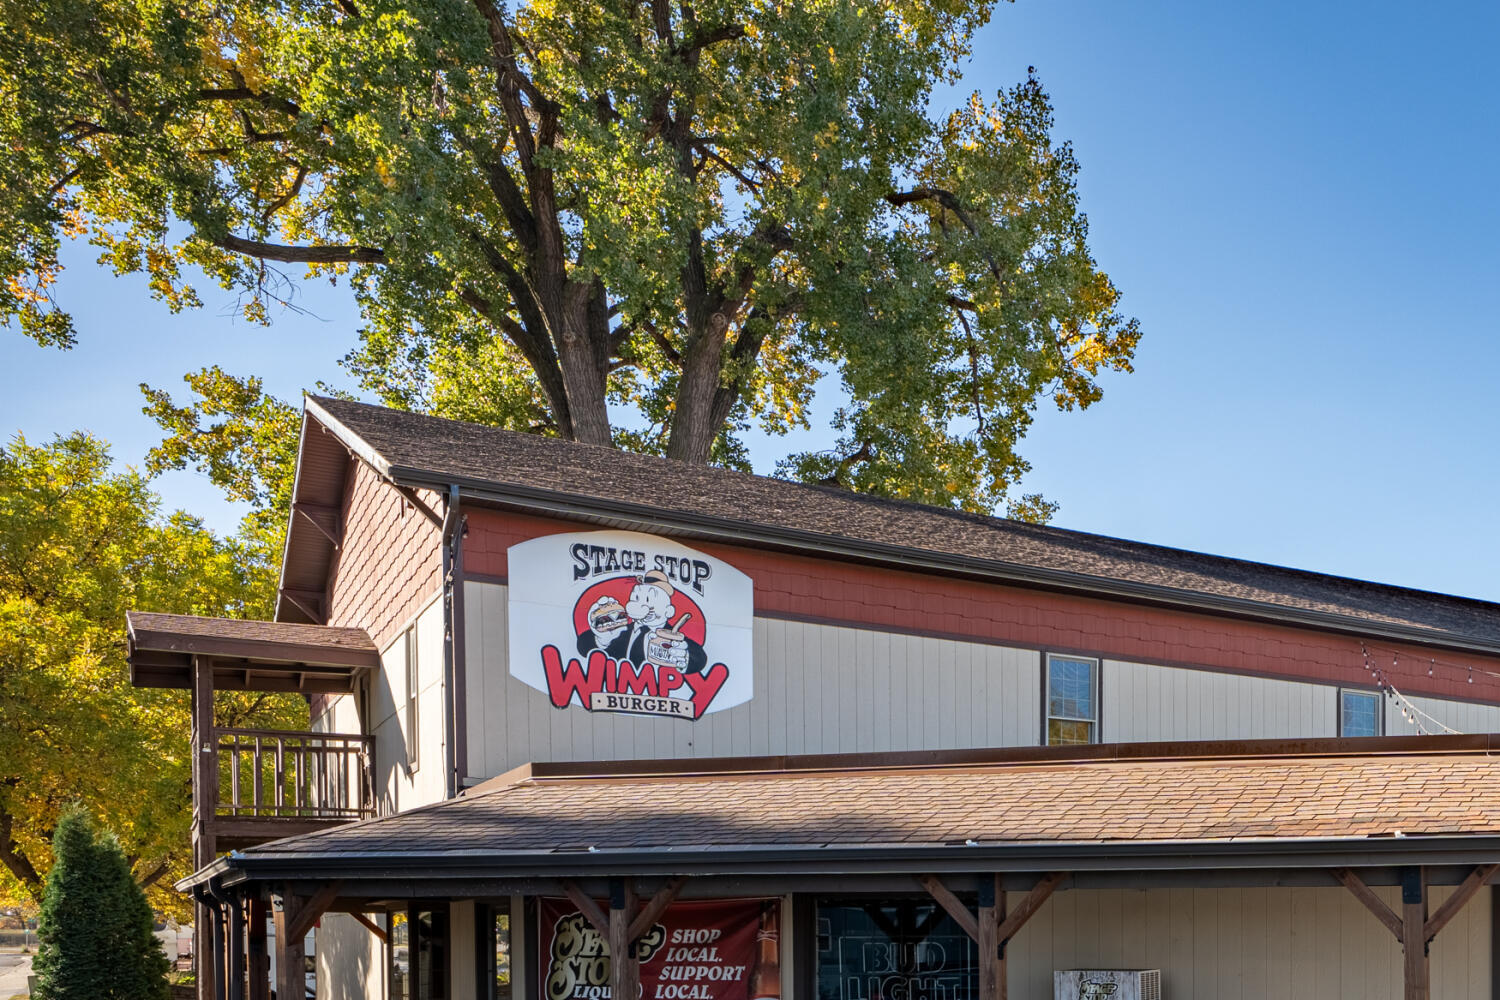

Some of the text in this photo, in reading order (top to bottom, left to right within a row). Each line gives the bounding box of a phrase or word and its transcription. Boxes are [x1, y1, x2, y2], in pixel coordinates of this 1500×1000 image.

[570, 542, 713, 597] STAGE STOP
[540, 644, 730, 722] WIMPY
[606, 695, 681, 714] BURGER
[671, 928, 722, 944] SHOP
[665, 947, 723, 963] LOCAL.
[862, 942, 946, 975] BUD
[658, 965, 746, 982] SUPPORT
[654, 984, 714, 1000] LOCAL.
